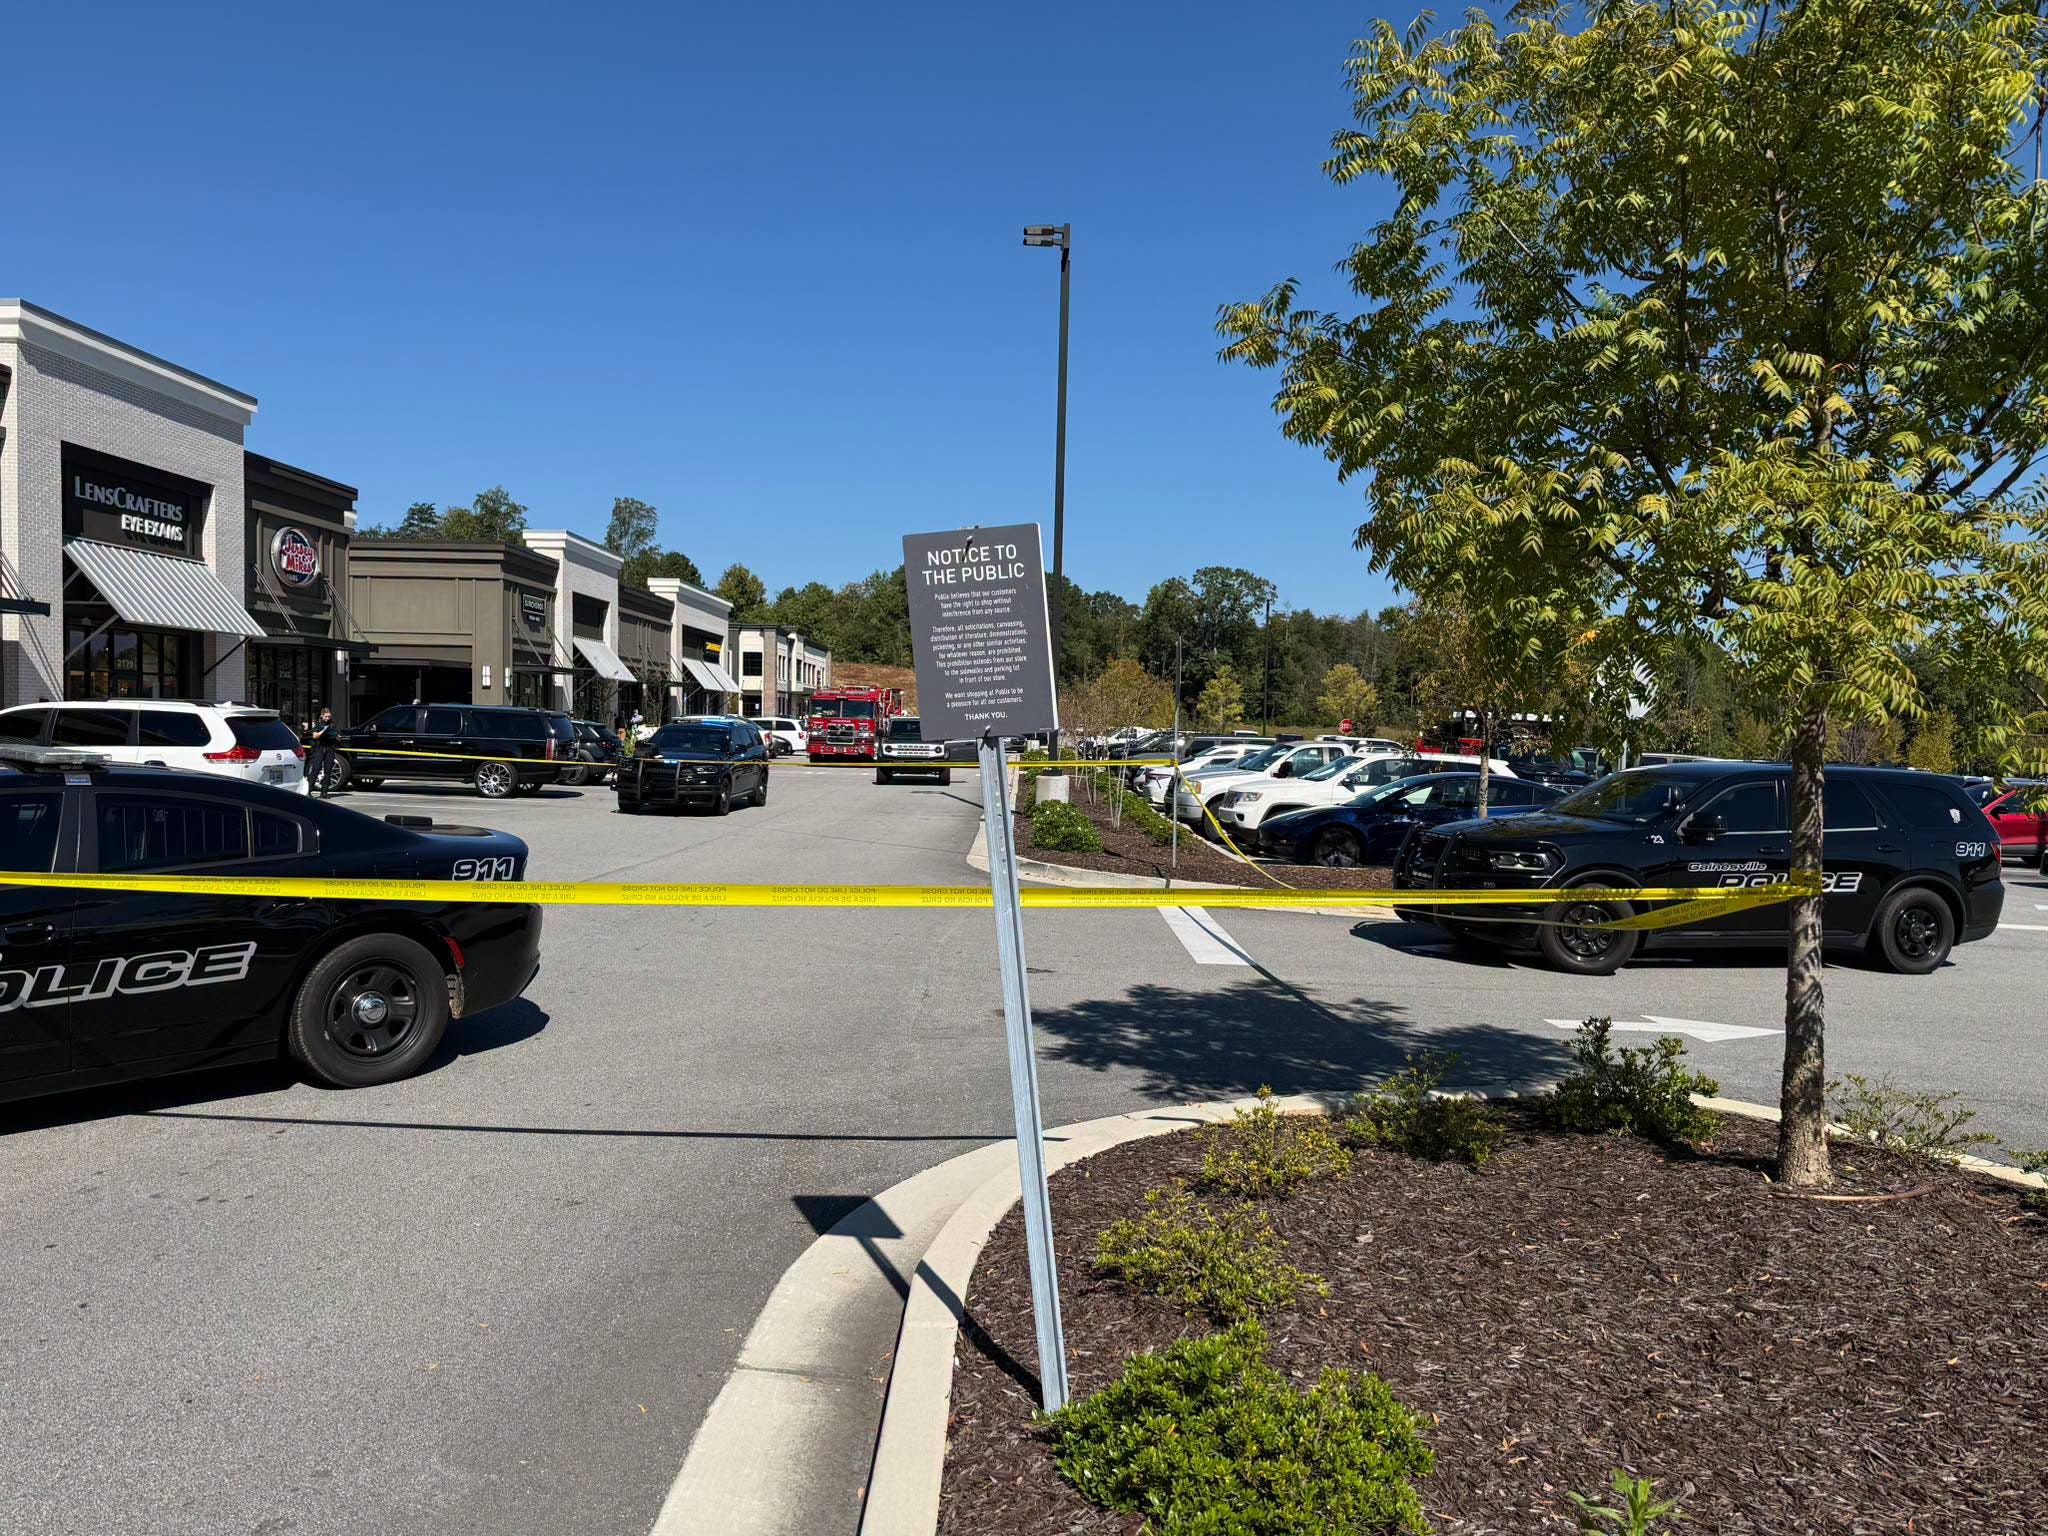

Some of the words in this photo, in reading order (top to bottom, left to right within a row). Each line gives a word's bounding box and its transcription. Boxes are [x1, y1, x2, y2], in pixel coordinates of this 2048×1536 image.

[122, 514, 143, 533] EYE
[144, 520, 183, 541] EXAMS
[927, 546, 990, 566] NOTICE
[994, 544, 1016, 560] TO
[922, 568, 956, 585] THE
[962, 563, 1024, 582] PUBLIC
[962, 600, 973, 608] right
[947, 659, 972, 668] prohibition
[1650, 835, 1664, 843] 23
[1956, 842, 1985, 856] 911
[452, 857, 514, 881] 911
[1688, 862, 1767, 871] Gainesville
